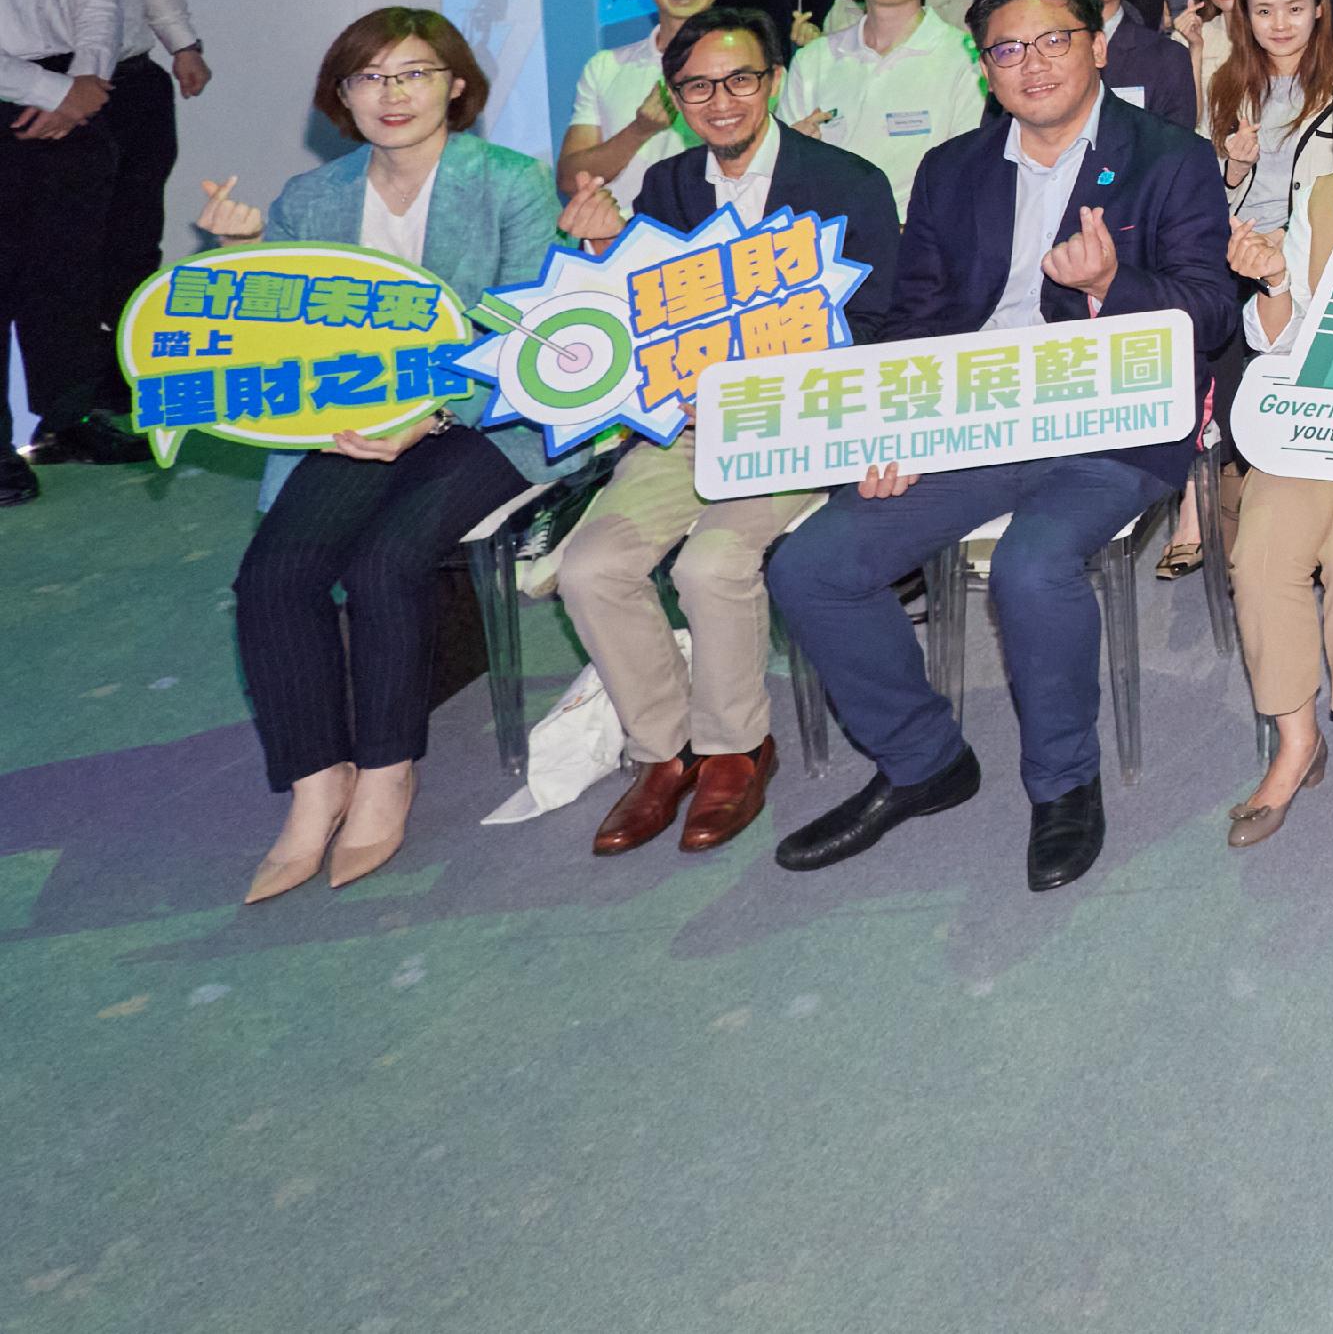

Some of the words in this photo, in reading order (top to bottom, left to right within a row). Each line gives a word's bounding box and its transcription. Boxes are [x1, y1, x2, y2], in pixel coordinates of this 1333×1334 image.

[166, 267, 440, 330] 計劃未來
[632, 217, 817, 332] 理財
[152, 330, 232, 357] 踏上
[639, 289, 829, 409] 攻略
[138, 345, 469, 427] 理財之路
[719, 328, 1173, 442] 青年發展藍圖
[717, 445, 809, 482] YOUTH
[826, 420, 1020, 469] DEVELOPMENT
[1032, 401, 1173, 442] BLUEPRINT
